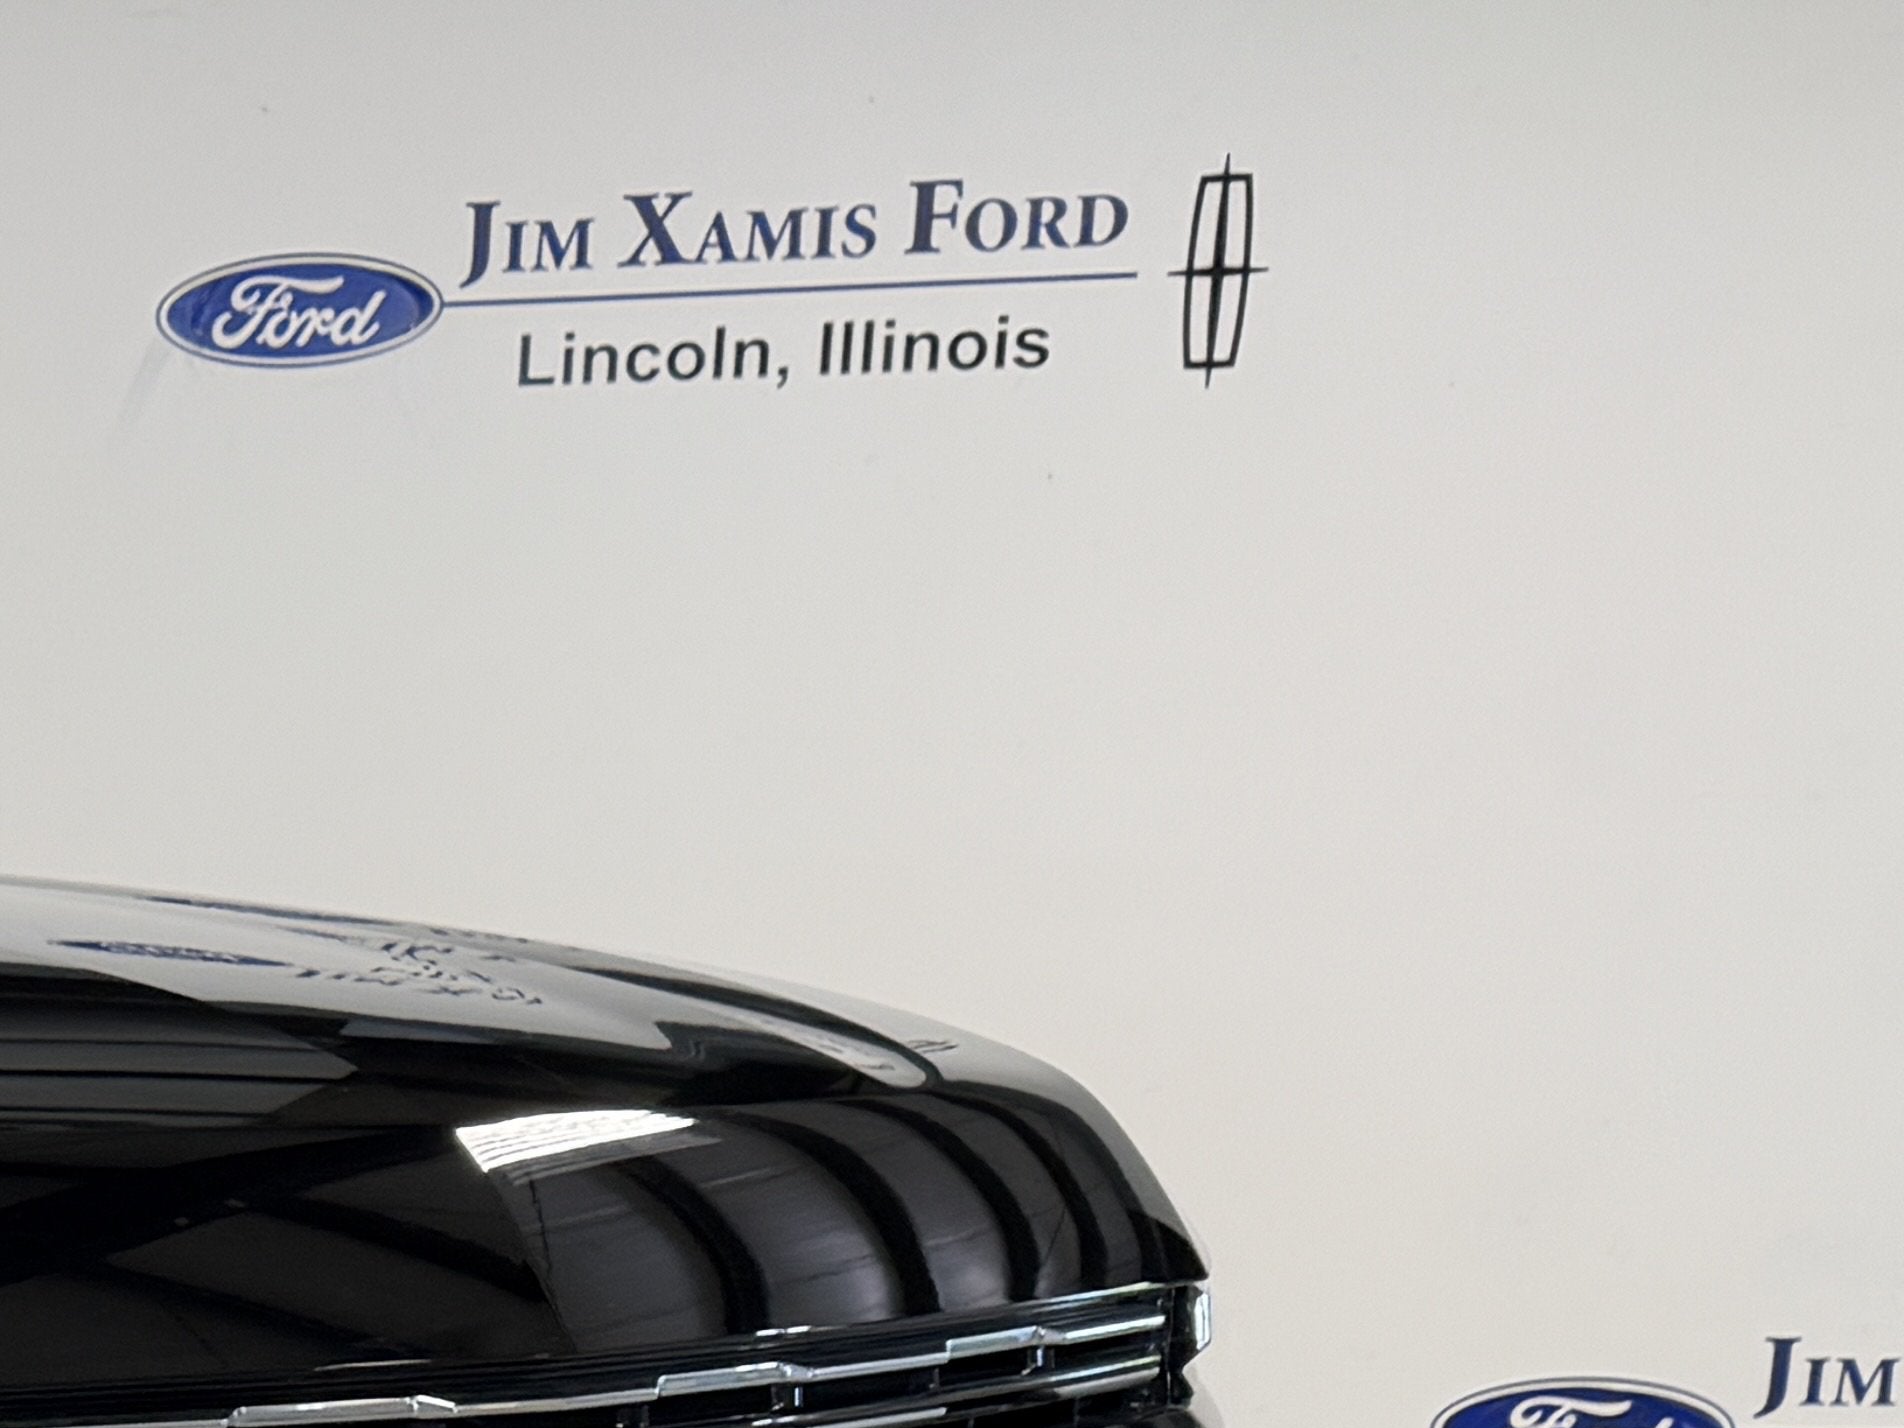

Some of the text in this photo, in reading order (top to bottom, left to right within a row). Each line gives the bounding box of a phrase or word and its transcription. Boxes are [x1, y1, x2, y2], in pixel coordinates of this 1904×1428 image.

[459, 178, 1129, 290] JIM XAMIS FORD
[211, 274, 387, 350] Ford
[518, 314, 1050, 390] Lincoln, Illinois
[1752, 1335, 1903, 1420] JIM
